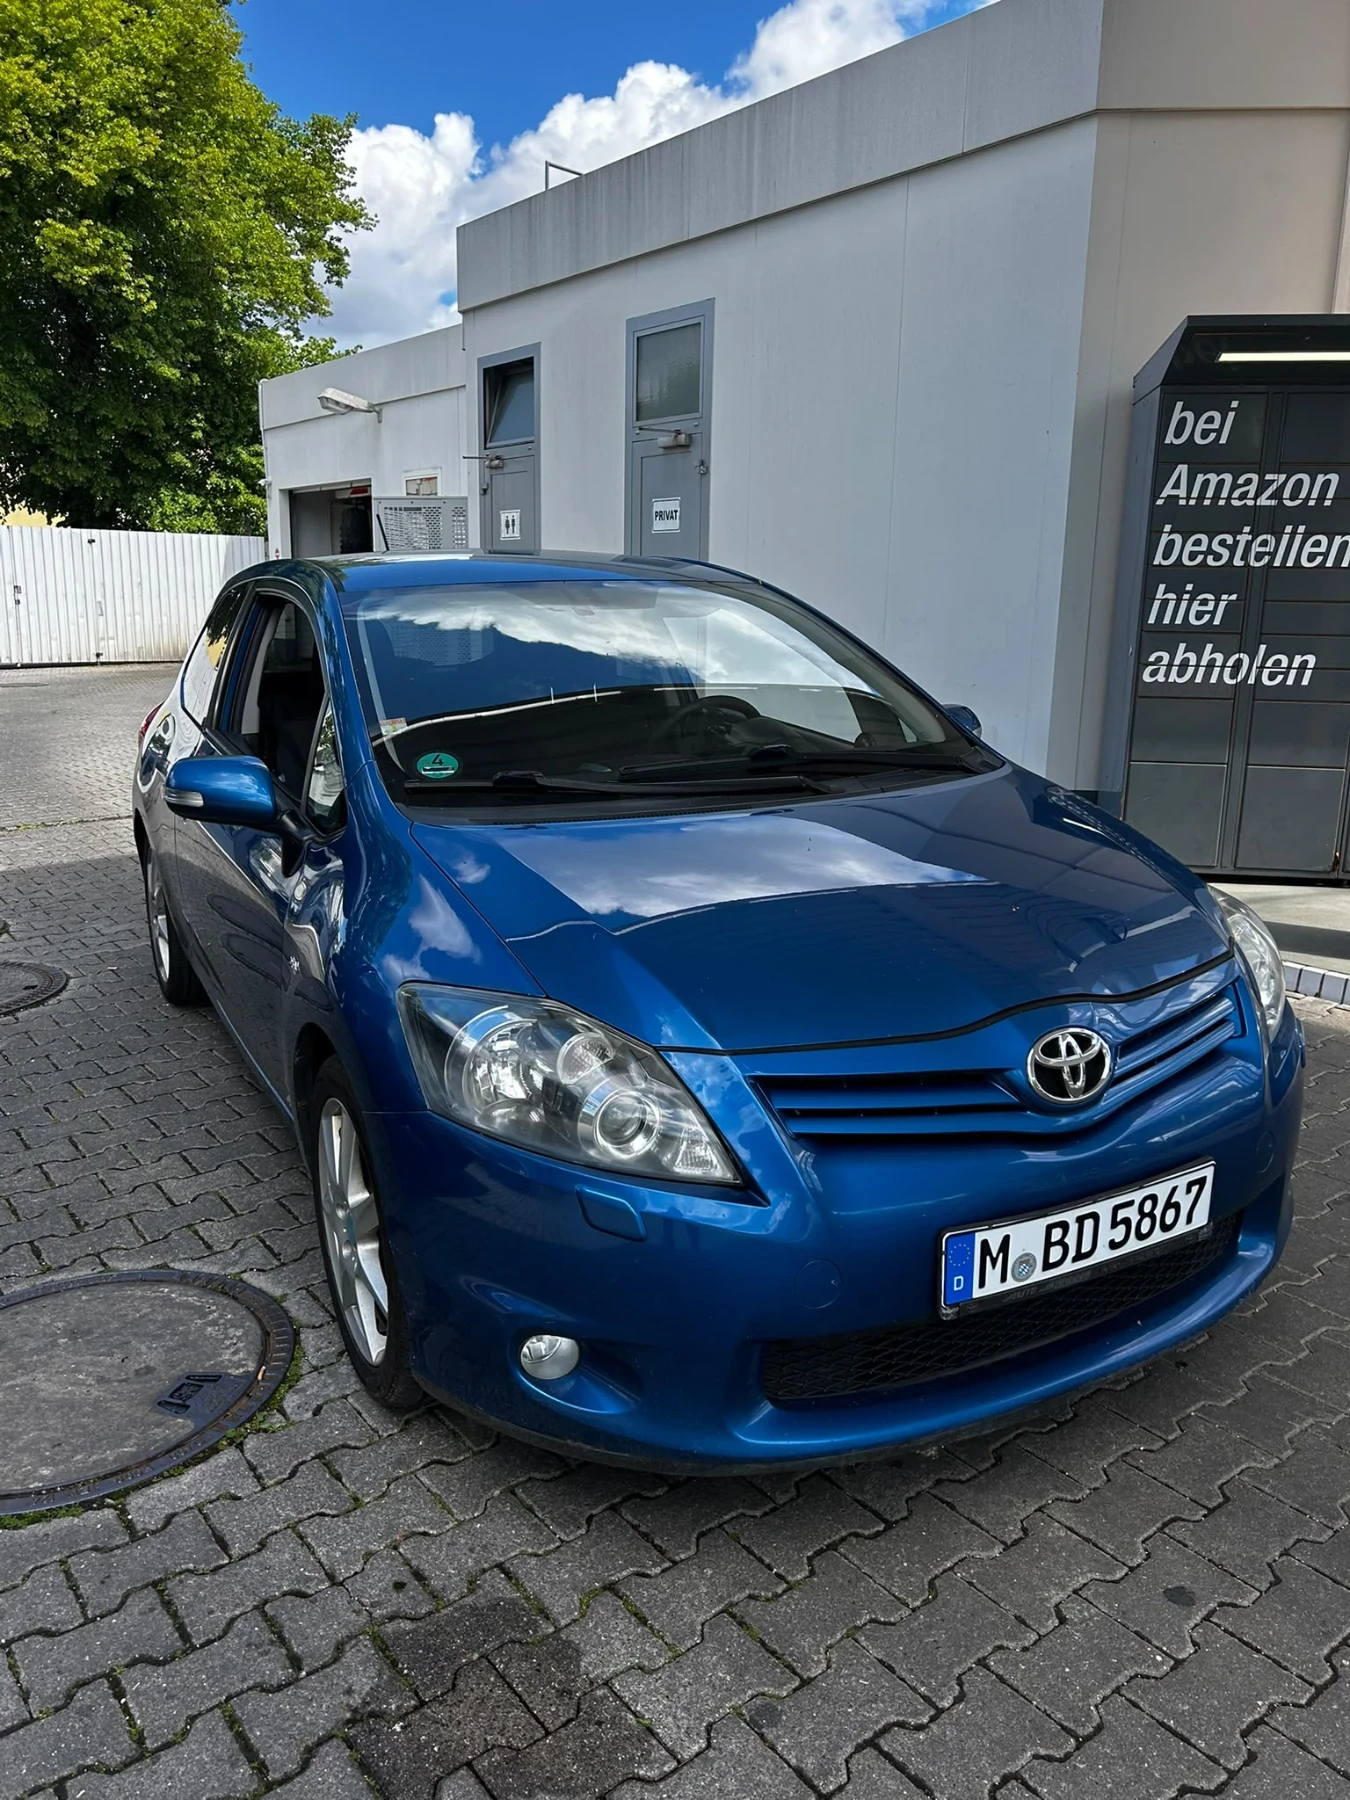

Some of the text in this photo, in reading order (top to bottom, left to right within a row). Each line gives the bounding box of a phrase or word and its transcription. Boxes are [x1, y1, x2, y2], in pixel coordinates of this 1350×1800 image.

[1164, 400, 1239, 445] bei
[1155, 464, 1340, 507] Amazon
[654, 509, 679, 521] PRIVAT
[1152, 524, 1350, 568] bestellen
[1147, 583, 1238, 626] hier
[1142, 643, 1317, 686] abholen
[431, 753, 445, 766] 4
[978, 1233, 1011, 1290] M
[1107, 1175, 1208, 1251] 5867
[953, 1275, 964, 1291] D
